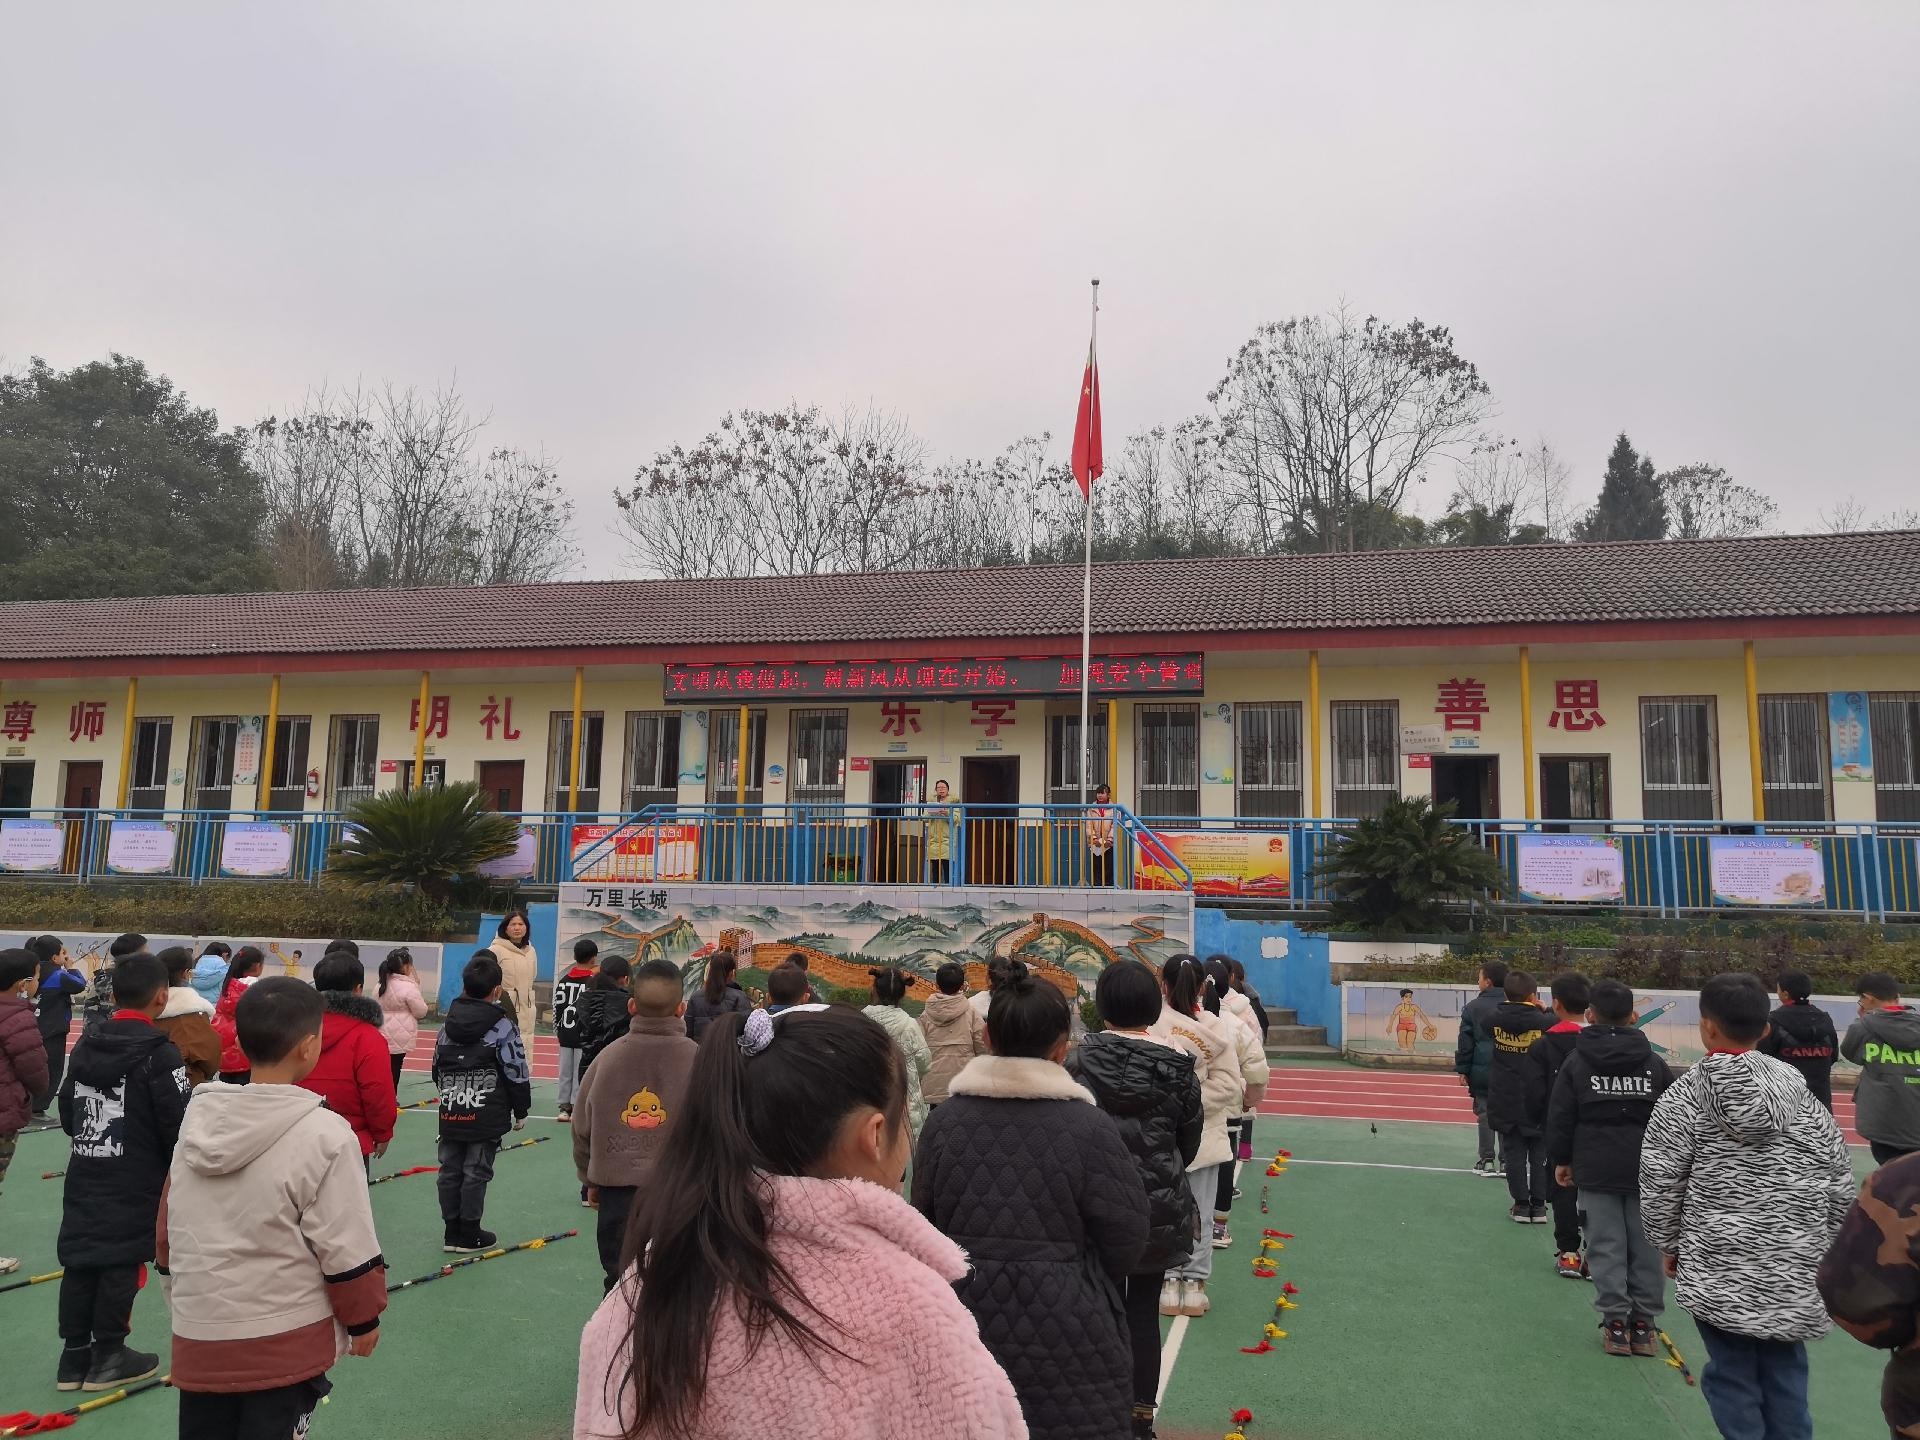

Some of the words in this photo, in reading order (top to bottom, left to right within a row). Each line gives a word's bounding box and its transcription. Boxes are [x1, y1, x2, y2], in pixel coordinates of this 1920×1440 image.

[586, 888, 668, 910] 万里长城
[1590, 1075, 1652, 1092] STARTE
